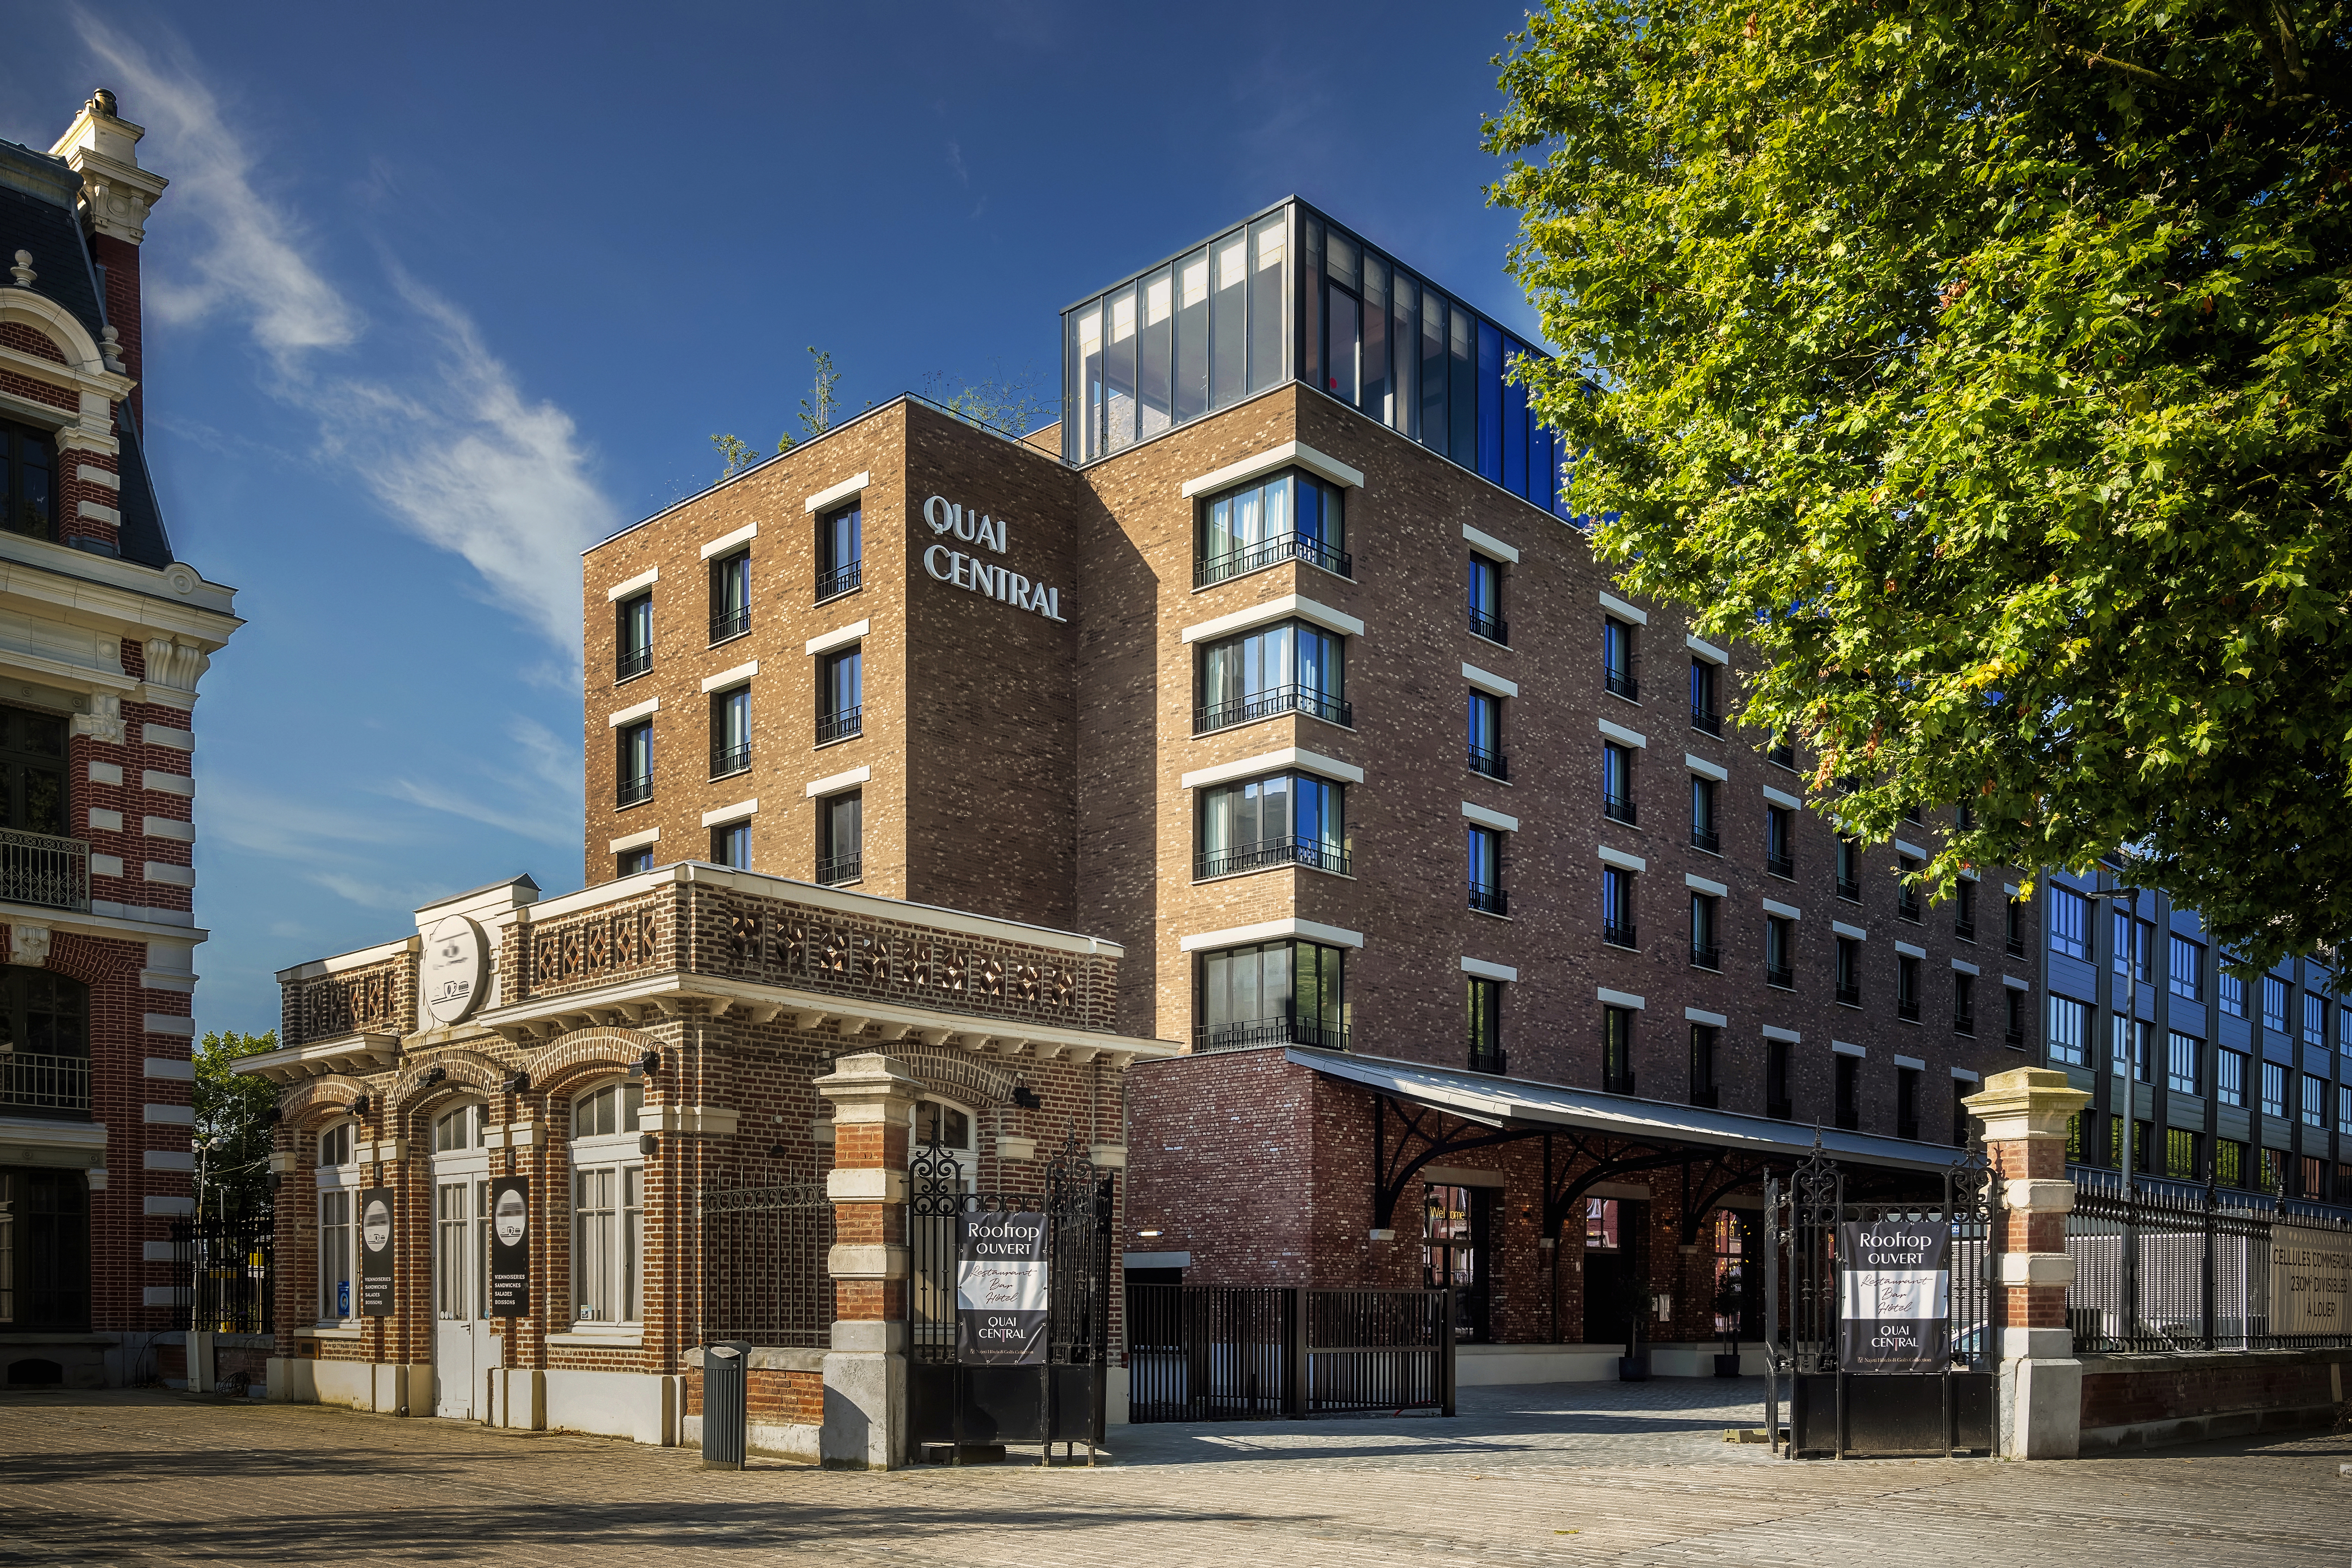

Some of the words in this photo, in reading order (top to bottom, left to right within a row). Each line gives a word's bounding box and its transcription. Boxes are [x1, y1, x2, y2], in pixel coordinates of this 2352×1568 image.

[924, 495, 1006, 555] QUAI
[924, 545, 1067, 622] CENTRAL
[1430, 1206, 1465, 1220] Welome
[968, 1222, 1040, 1241] Rooftop
[1718, 1226, 1735, 1236] Hôel
[1860, 1232, 1932, 1250] Rooftop
[976, 1243, 1032, 1254] OUVERT
[1868, 1253, 1924, 1264] OUVERT
[2273, 1248, 2311, 1267] CELLULES
[969, 1265, 1038, 1277] Restaurant
[989, 1278, 1014, 1290] Bar
[1861, 1274, 1933, 1287] Restaurant
[2314, 1277, 2348, 1293] DIVISIBLES
[986, 1291, 1018, 1304] Hôtel
[1882, 1287, 1907, 1300] Bar
[1878, 1302, 1913, 1315] Hôtel
[2307, 1297, 2312, 1317] À
[2314, 1301, 2335, 1317] LOUER
[988, 1317, 1016, 1328] QUAI
[978, 1329, 1026, 1343] CENTRAL
[1881, 1326, 1909, 1337] QUAI
[1872, 1338, 1918, 1351] CENTRAL
